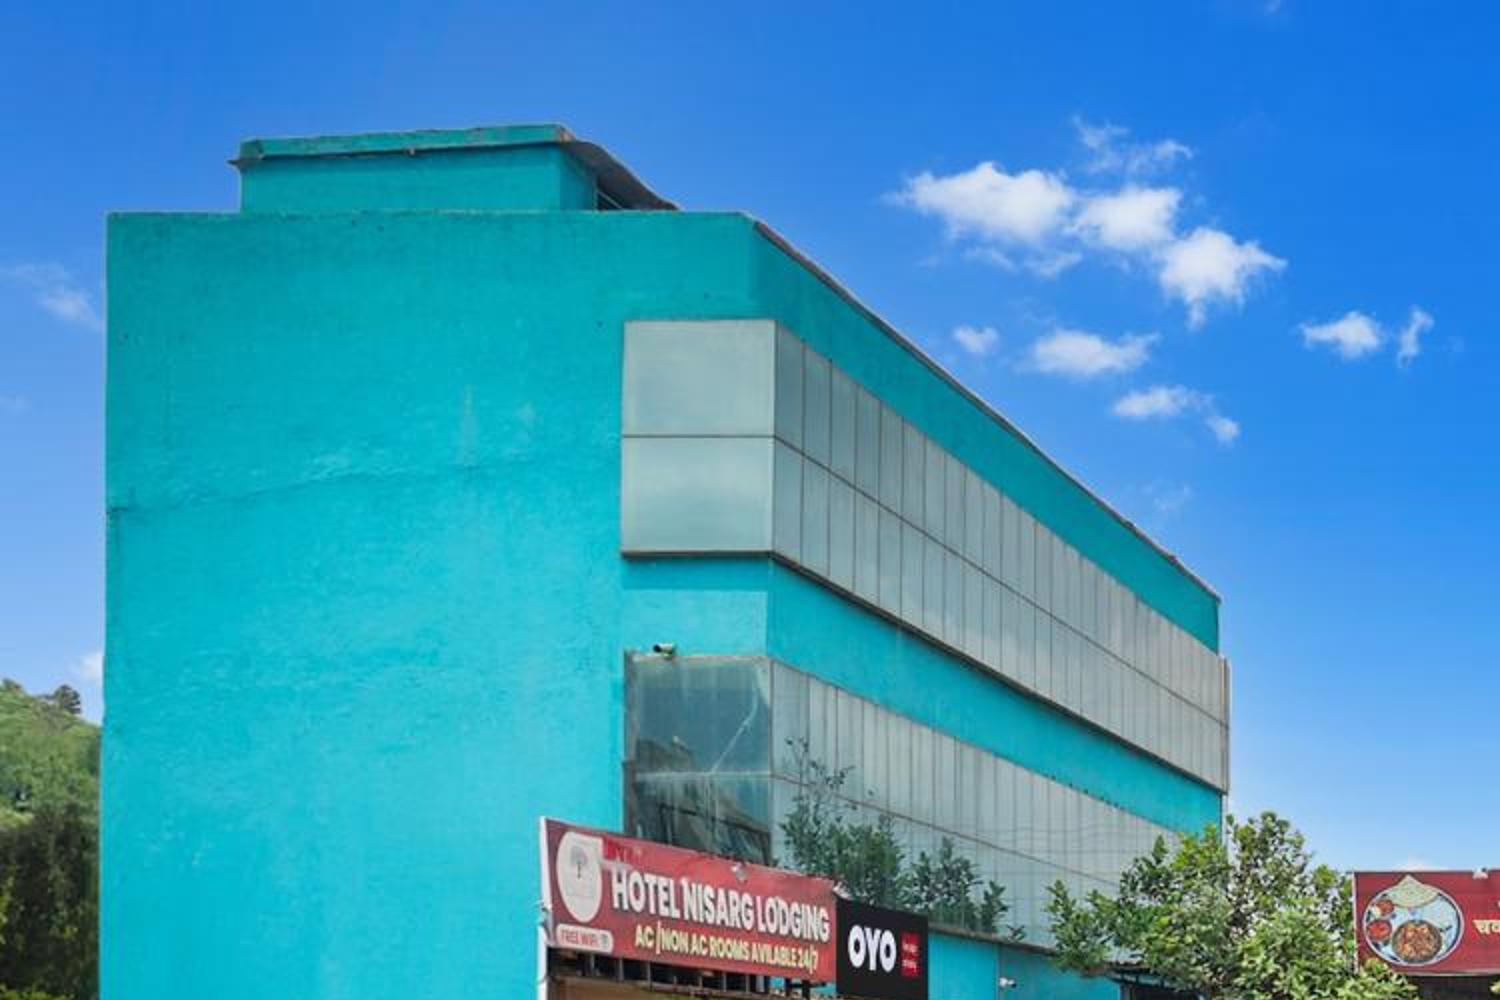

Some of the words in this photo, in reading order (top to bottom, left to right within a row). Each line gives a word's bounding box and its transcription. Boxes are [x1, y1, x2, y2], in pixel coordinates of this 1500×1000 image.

[611, 866, 680, 919] HOTEL
[680, 877, 754, 931] NISARG
[756, 895, 829, 942] LODGING
[635, 924, 655, 949] AC
[690, 933, 708, 956] AC
[709, 936, 750, 962] ROOMS
[848, 924, 897, 973] OYO
